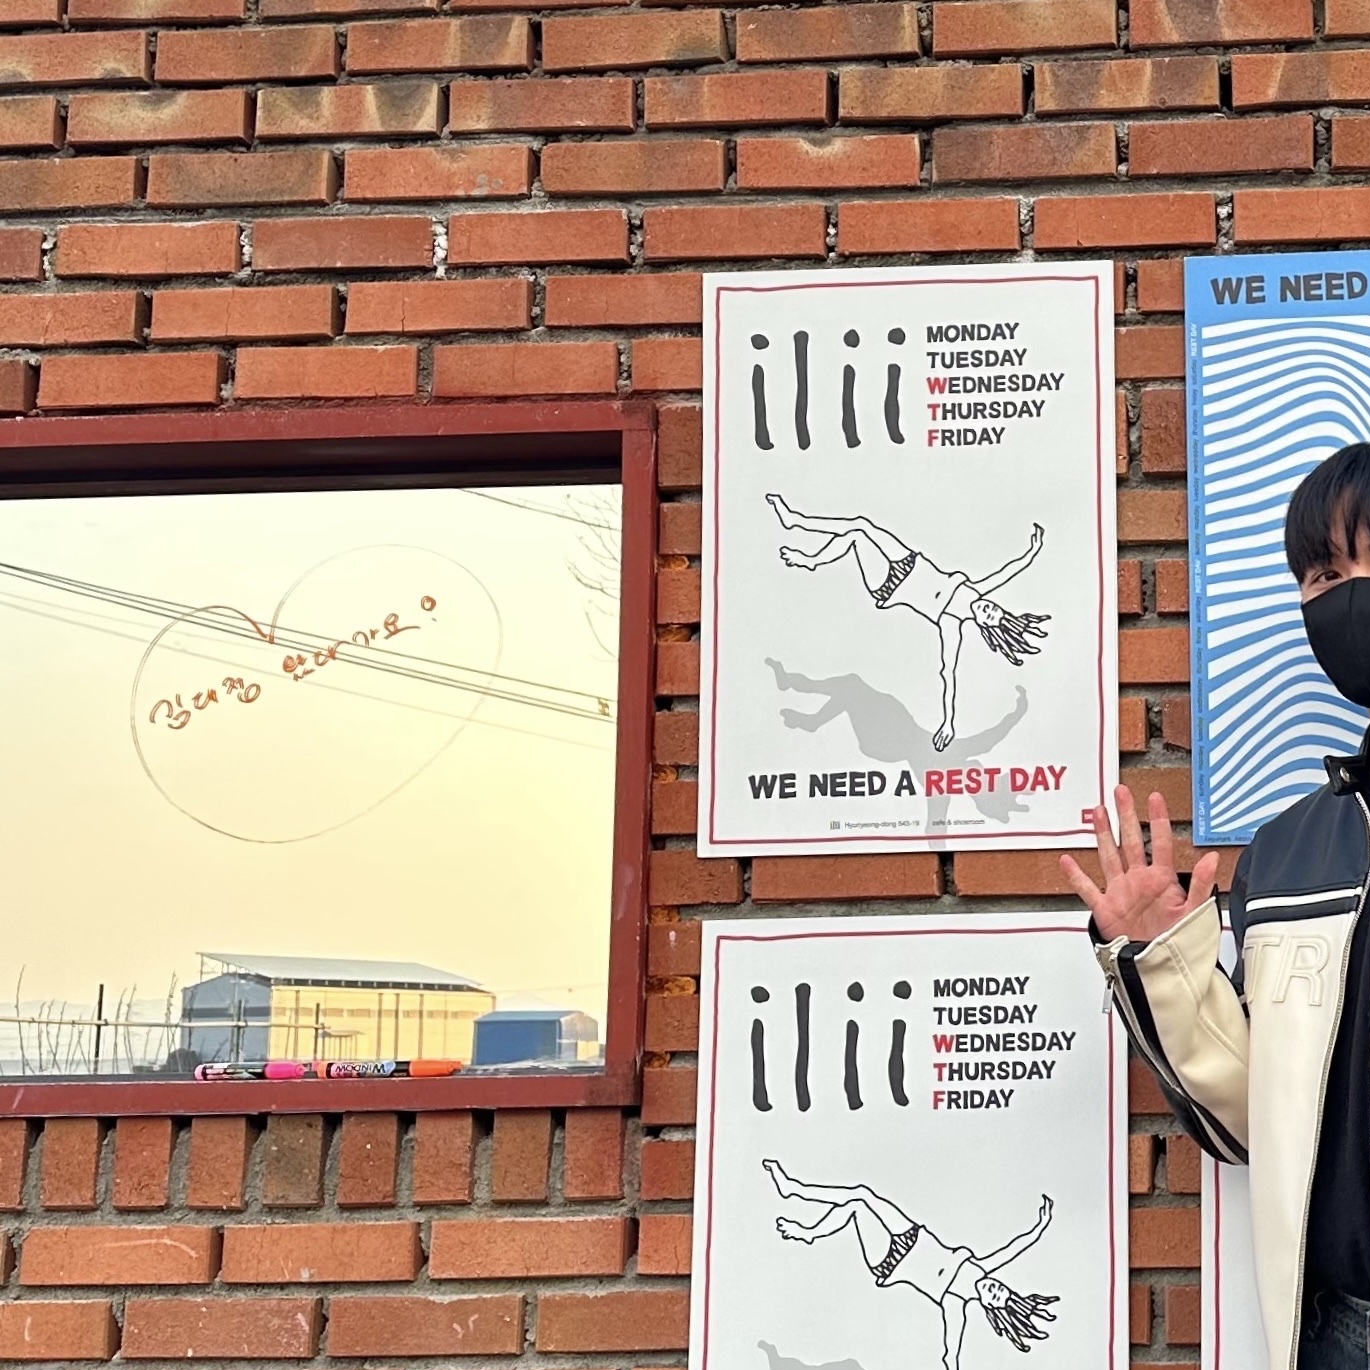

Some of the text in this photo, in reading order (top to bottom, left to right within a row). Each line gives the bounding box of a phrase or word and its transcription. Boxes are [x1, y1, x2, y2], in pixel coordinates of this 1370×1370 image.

[1211, 276, 1265, 304] WE
[1280, 272, 1367, 302] NEED
[927, 323, 1019, 342] MONDAY
[927, 349, 1026, 368] TUESDAY
[927, 373, 1064, 394] WEDNESDAY
[928, 400, 1045, 420] THURSDAY
[928, 427, 1005, 446] FRIDAY
[749, 766, 1066, 799] WE NEED A REST DAY
[933, 977, 1029, 997] MONDAY
[934, 1005, 1037, 1025] TUESDAY
[933, 1031, 1075, 1053] WEDNESDAY
[335, 1063, 386, 1074] WINDOW
[934, 1060, 1055, 1081] THURSDAY
[934, 1089, 1014, 1109] FRIDAY
